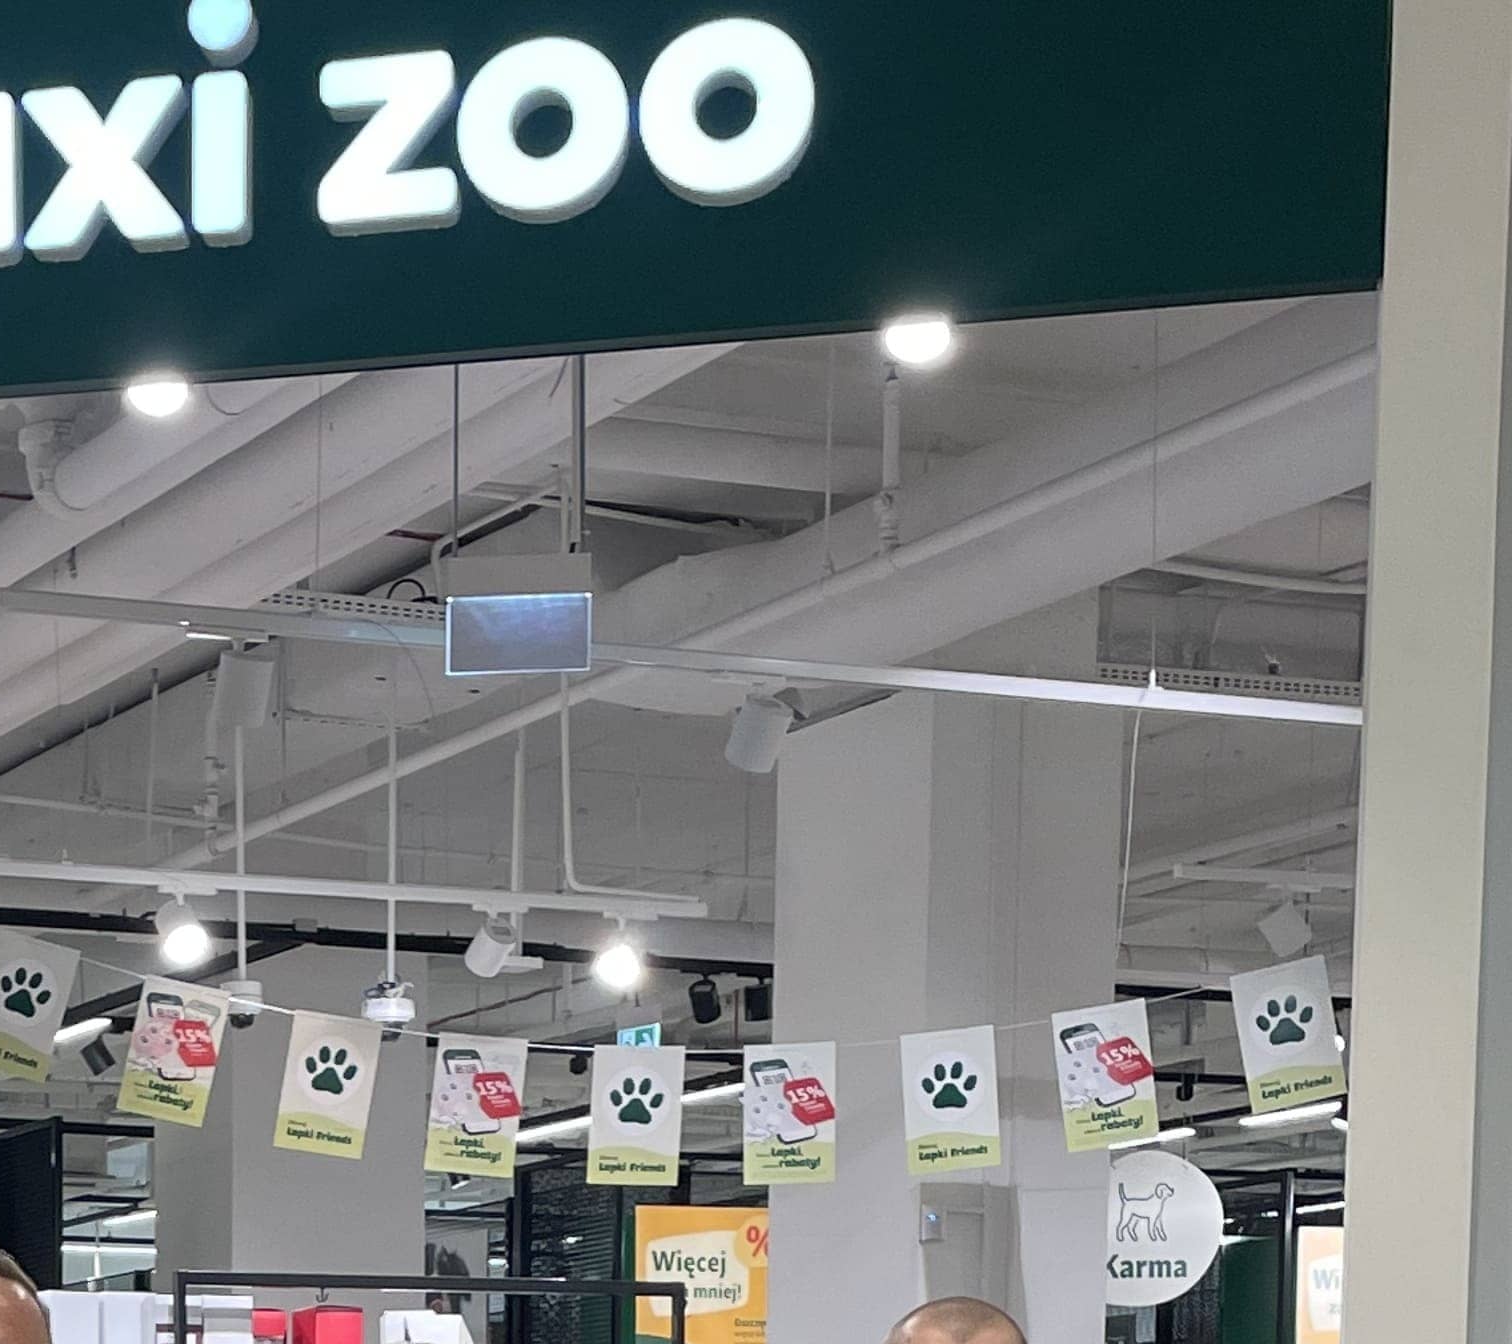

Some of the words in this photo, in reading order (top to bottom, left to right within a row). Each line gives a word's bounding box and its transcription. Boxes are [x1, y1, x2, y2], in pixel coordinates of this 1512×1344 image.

[317, 17, 816, 232] zoo
[175, 1026, 212, 1043] 15%
[1100, 1042, 1141, 1067] 15%
[476, 1080, 513, 1096] 15%
[787, 1086, 825, 1105] 15%
[652, 1250, 727, 1278] Więcej
[693, 1284, 742, 1304] mniej!
